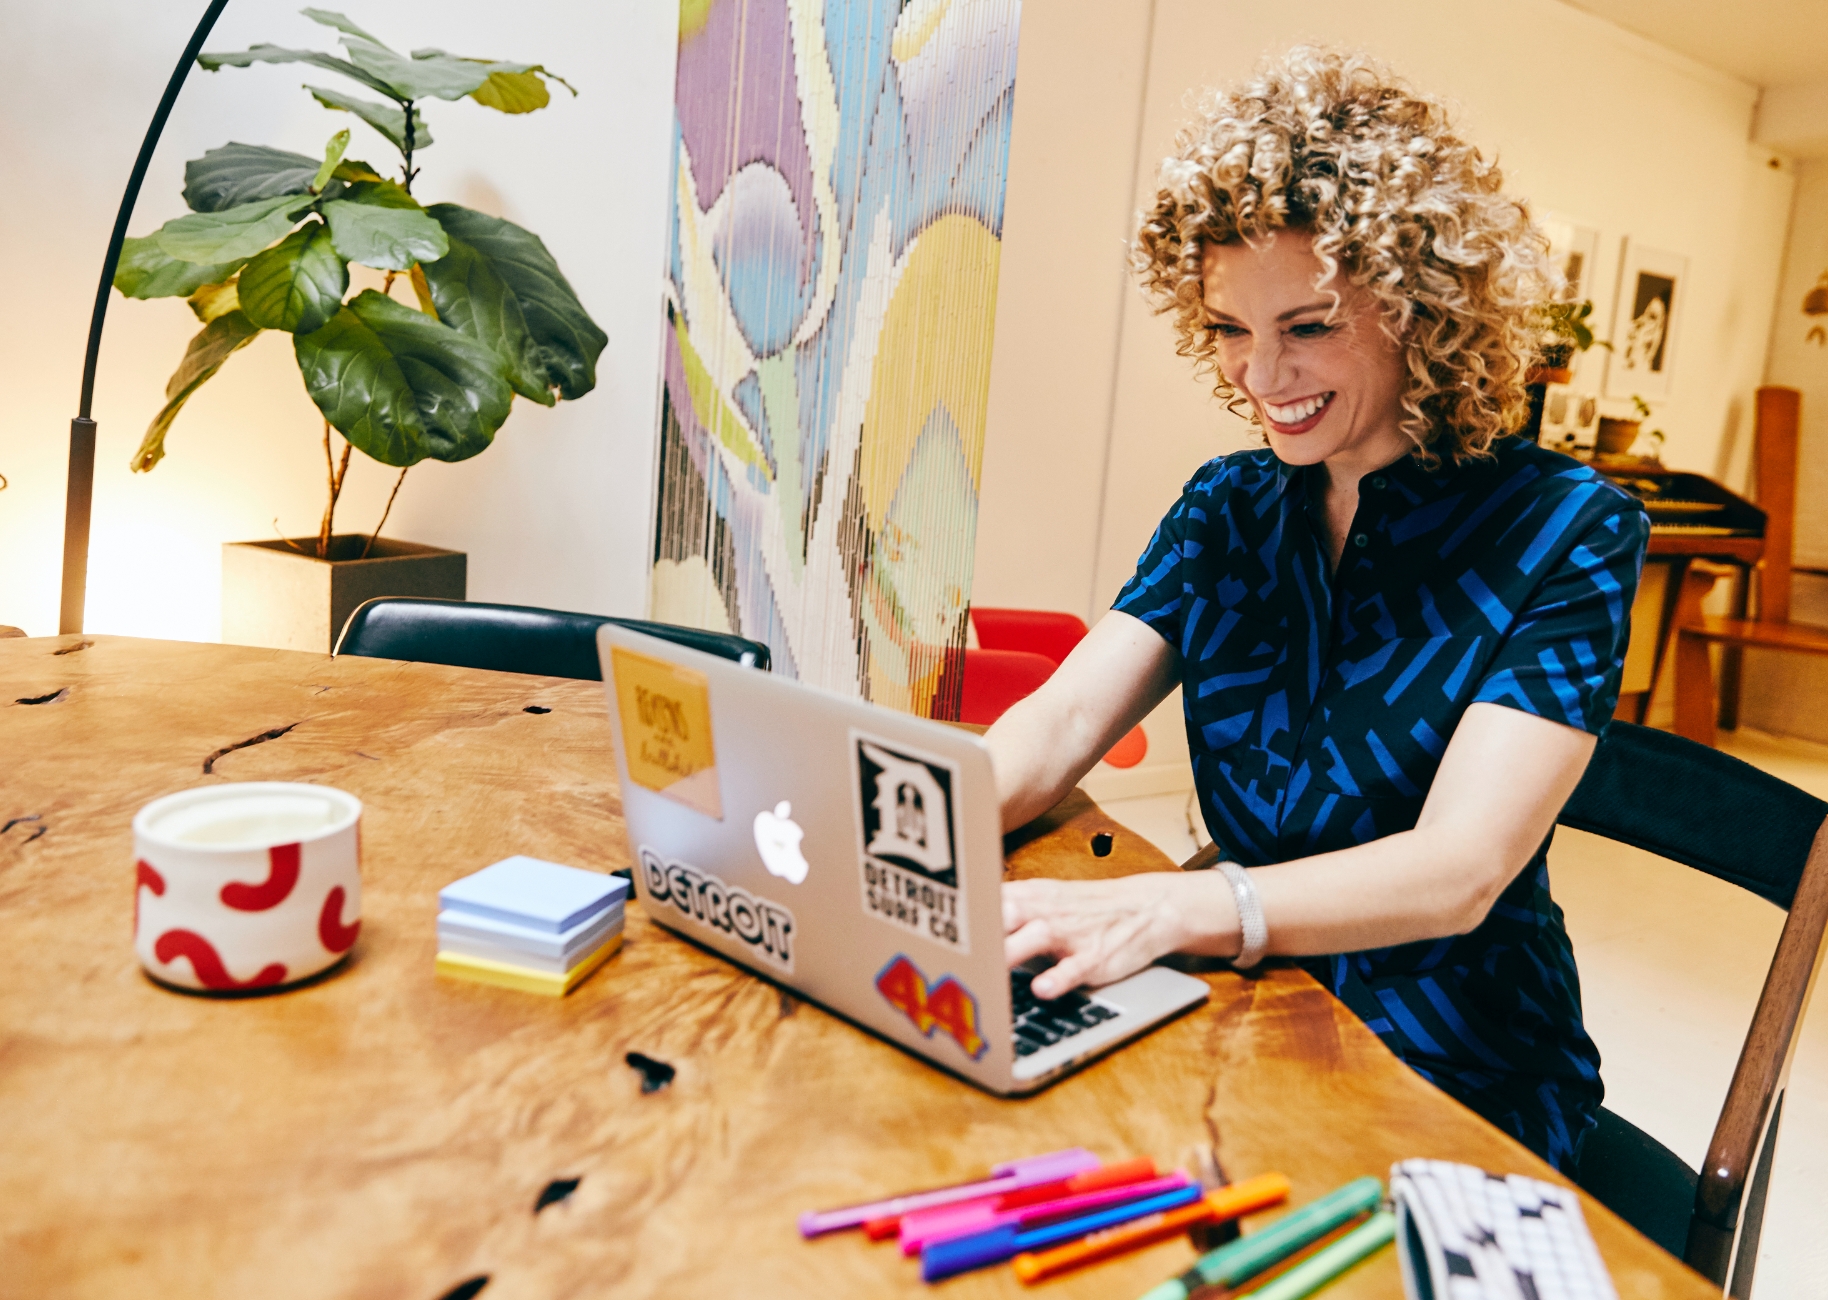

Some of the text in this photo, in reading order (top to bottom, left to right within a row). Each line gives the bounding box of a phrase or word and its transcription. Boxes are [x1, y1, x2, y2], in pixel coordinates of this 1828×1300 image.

[641, 849, 792, 961] DETROIT
[864, 861, 956, 918] DETROIT
[867, 887, 959, 944] SURF CO
[874, 952, 990, 1062] 44
